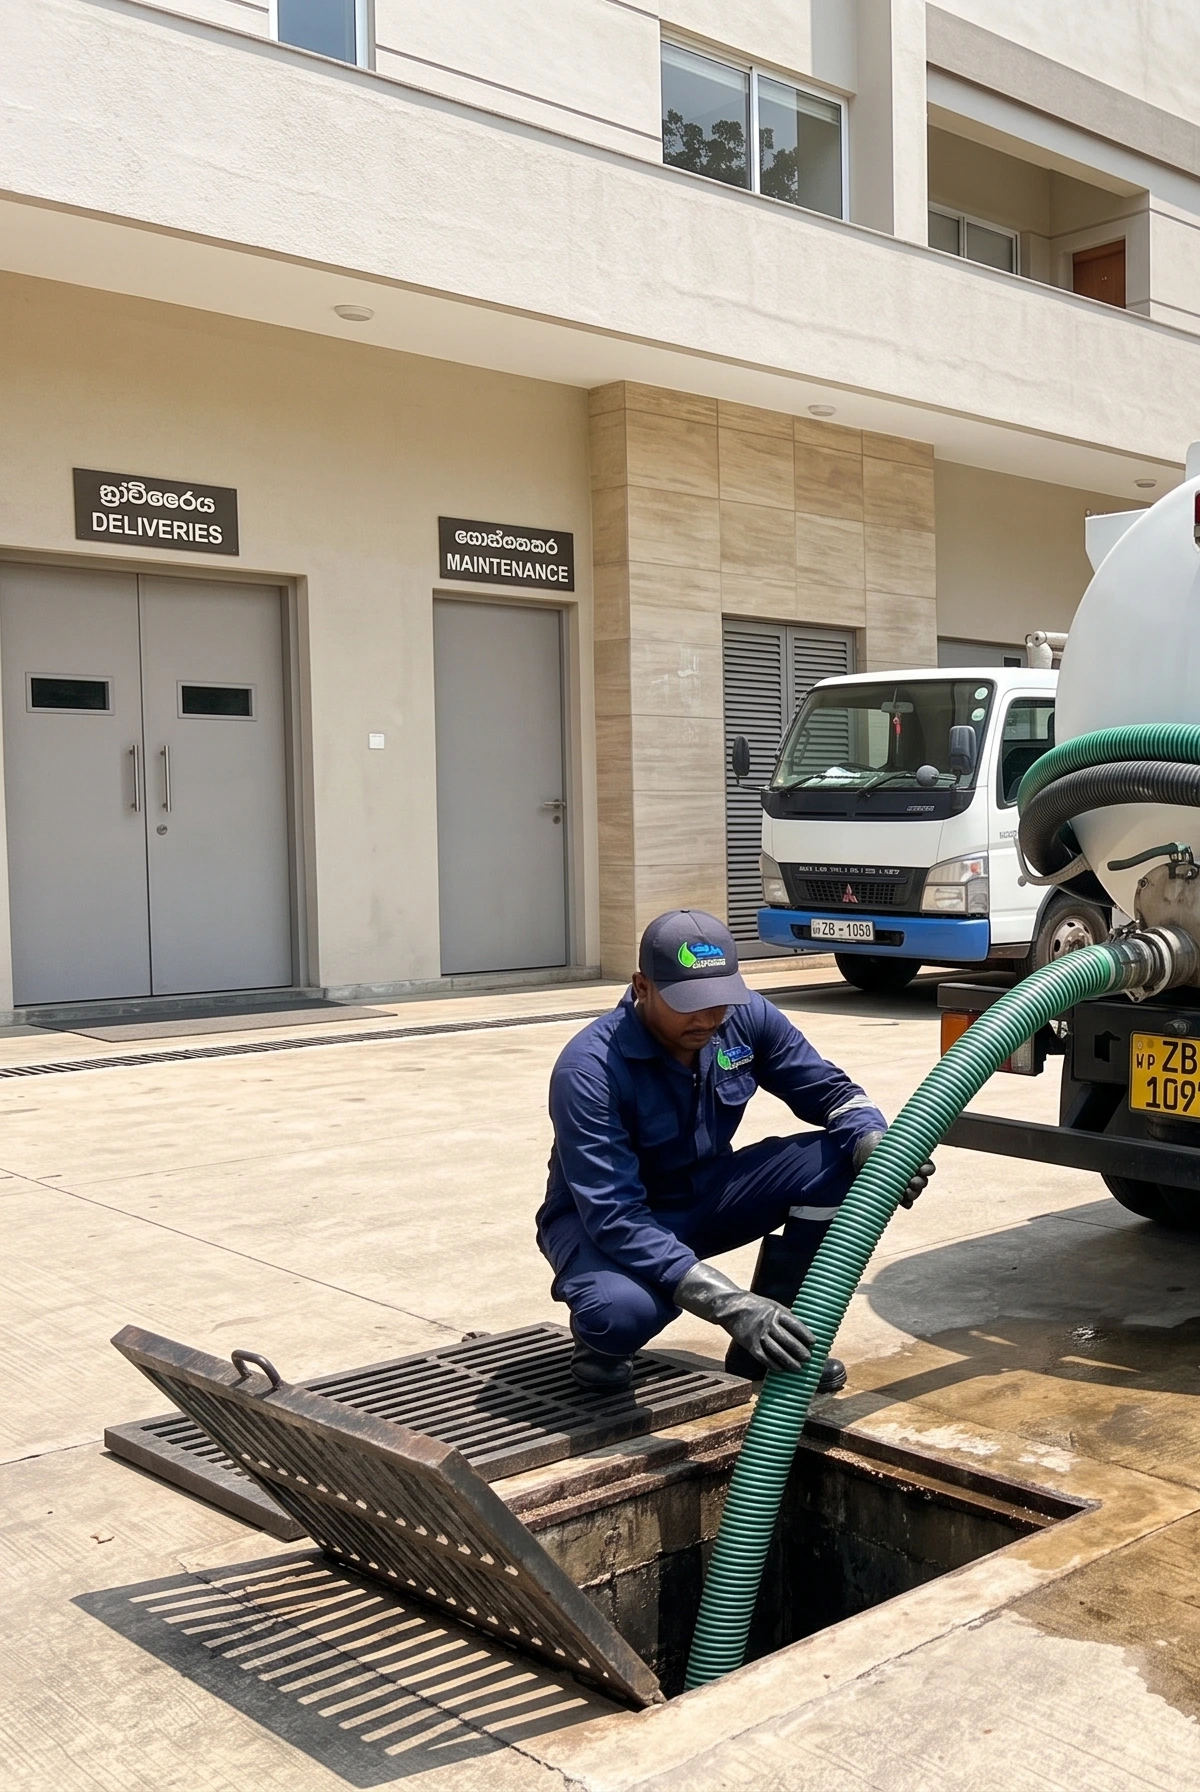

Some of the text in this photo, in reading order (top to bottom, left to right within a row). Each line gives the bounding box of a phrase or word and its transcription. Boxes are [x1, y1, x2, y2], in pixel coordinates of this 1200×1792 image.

[92, 511, 223, 544] DELIVERIES
[446, 553, 569, 582] MAINTENANCE
[1161, 1040, 1198, 1075] ZB
